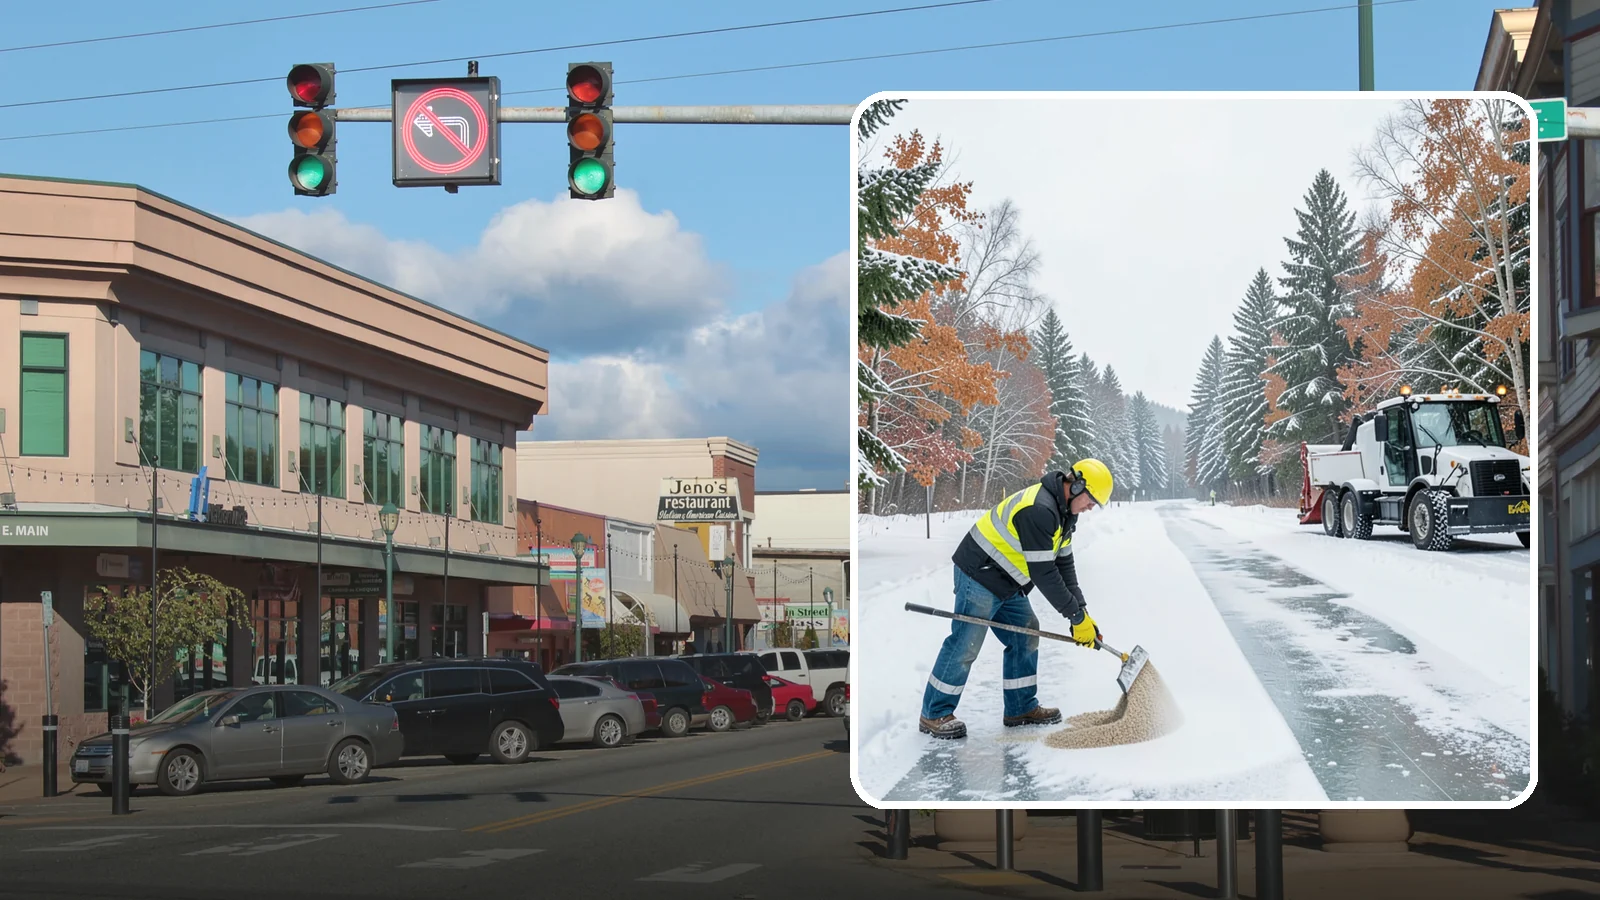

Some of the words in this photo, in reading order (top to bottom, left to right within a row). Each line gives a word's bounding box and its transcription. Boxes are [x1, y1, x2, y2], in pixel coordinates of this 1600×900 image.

[669, 480, 728, 494] Jeno's
[665, 496, 731, 509] restaurant
[686, 510, 714, 519] American
[715, 509, 738, 519] Cuisine
[2, 525, 13, 536] E.
[16, 525, 49, 536] MAIN
[797, 607, 828, 616] Street
